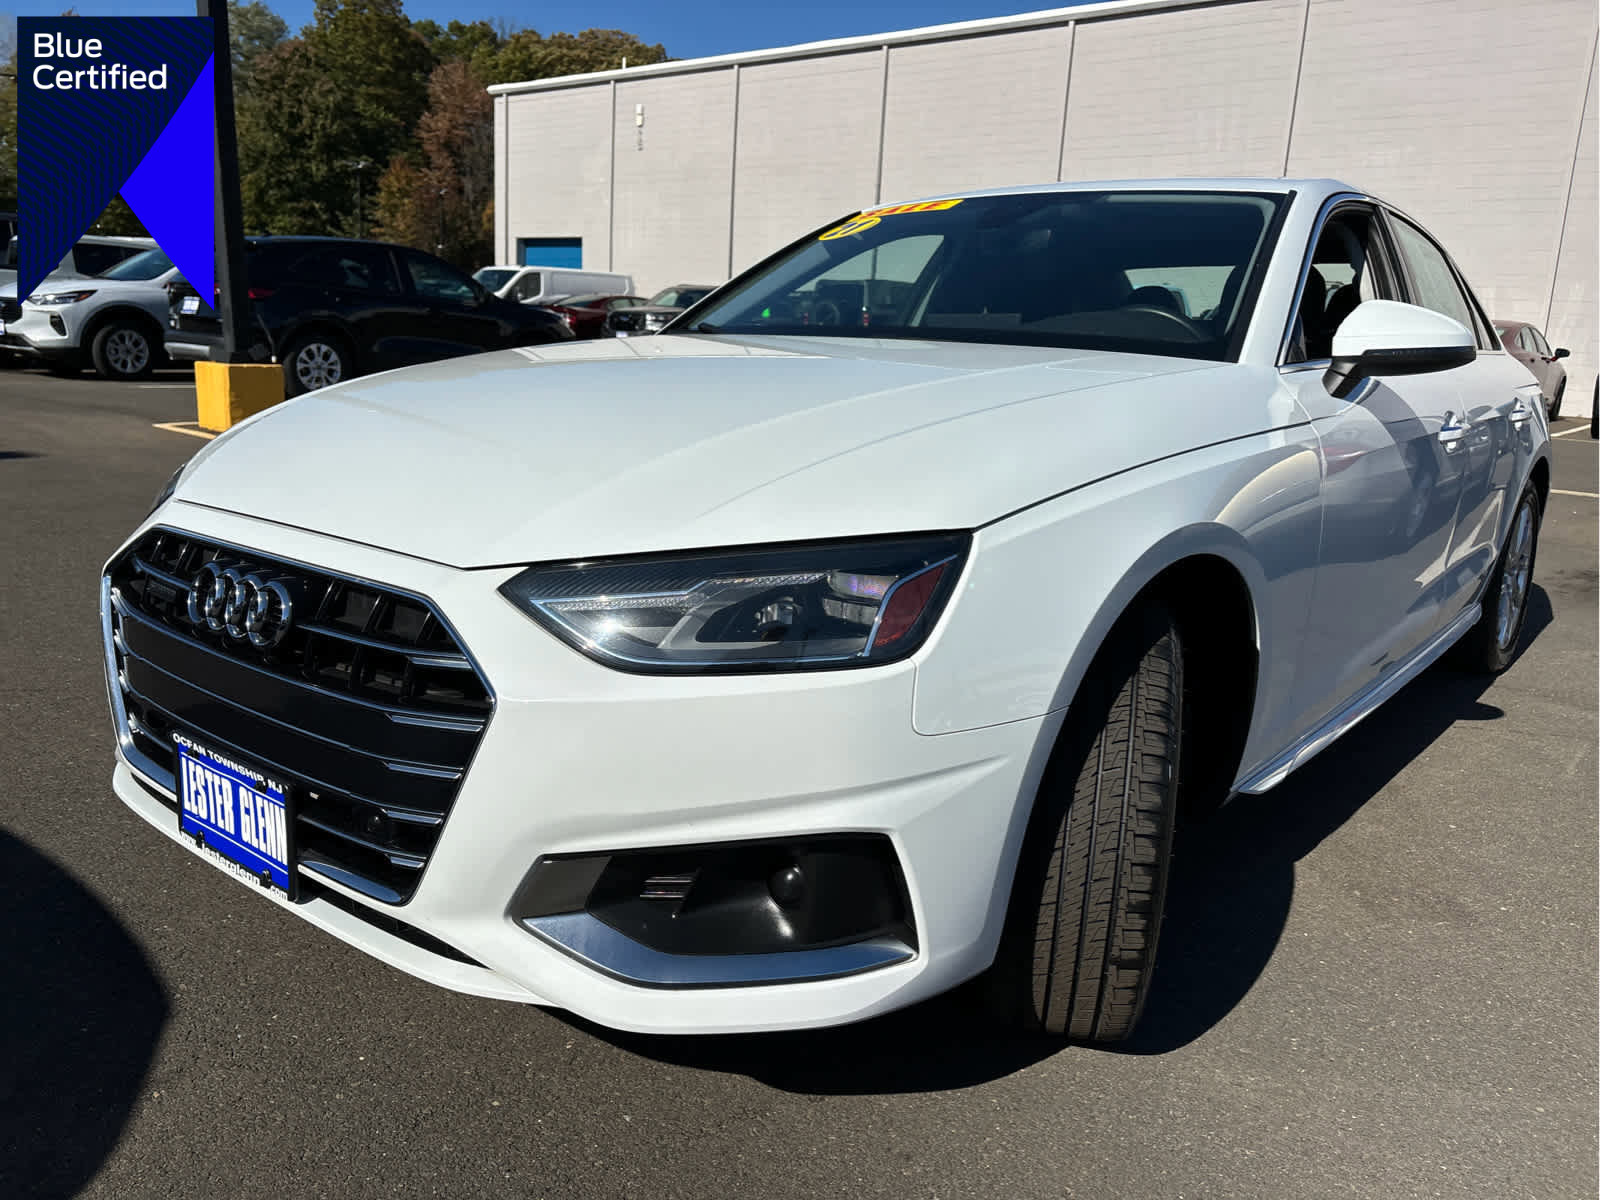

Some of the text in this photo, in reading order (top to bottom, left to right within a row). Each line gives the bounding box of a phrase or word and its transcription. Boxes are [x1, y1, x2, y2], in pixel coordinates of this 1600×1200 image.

[181, 757, 289, 867] LESTER GLENN
[267, 778, 284, 795] NJ
